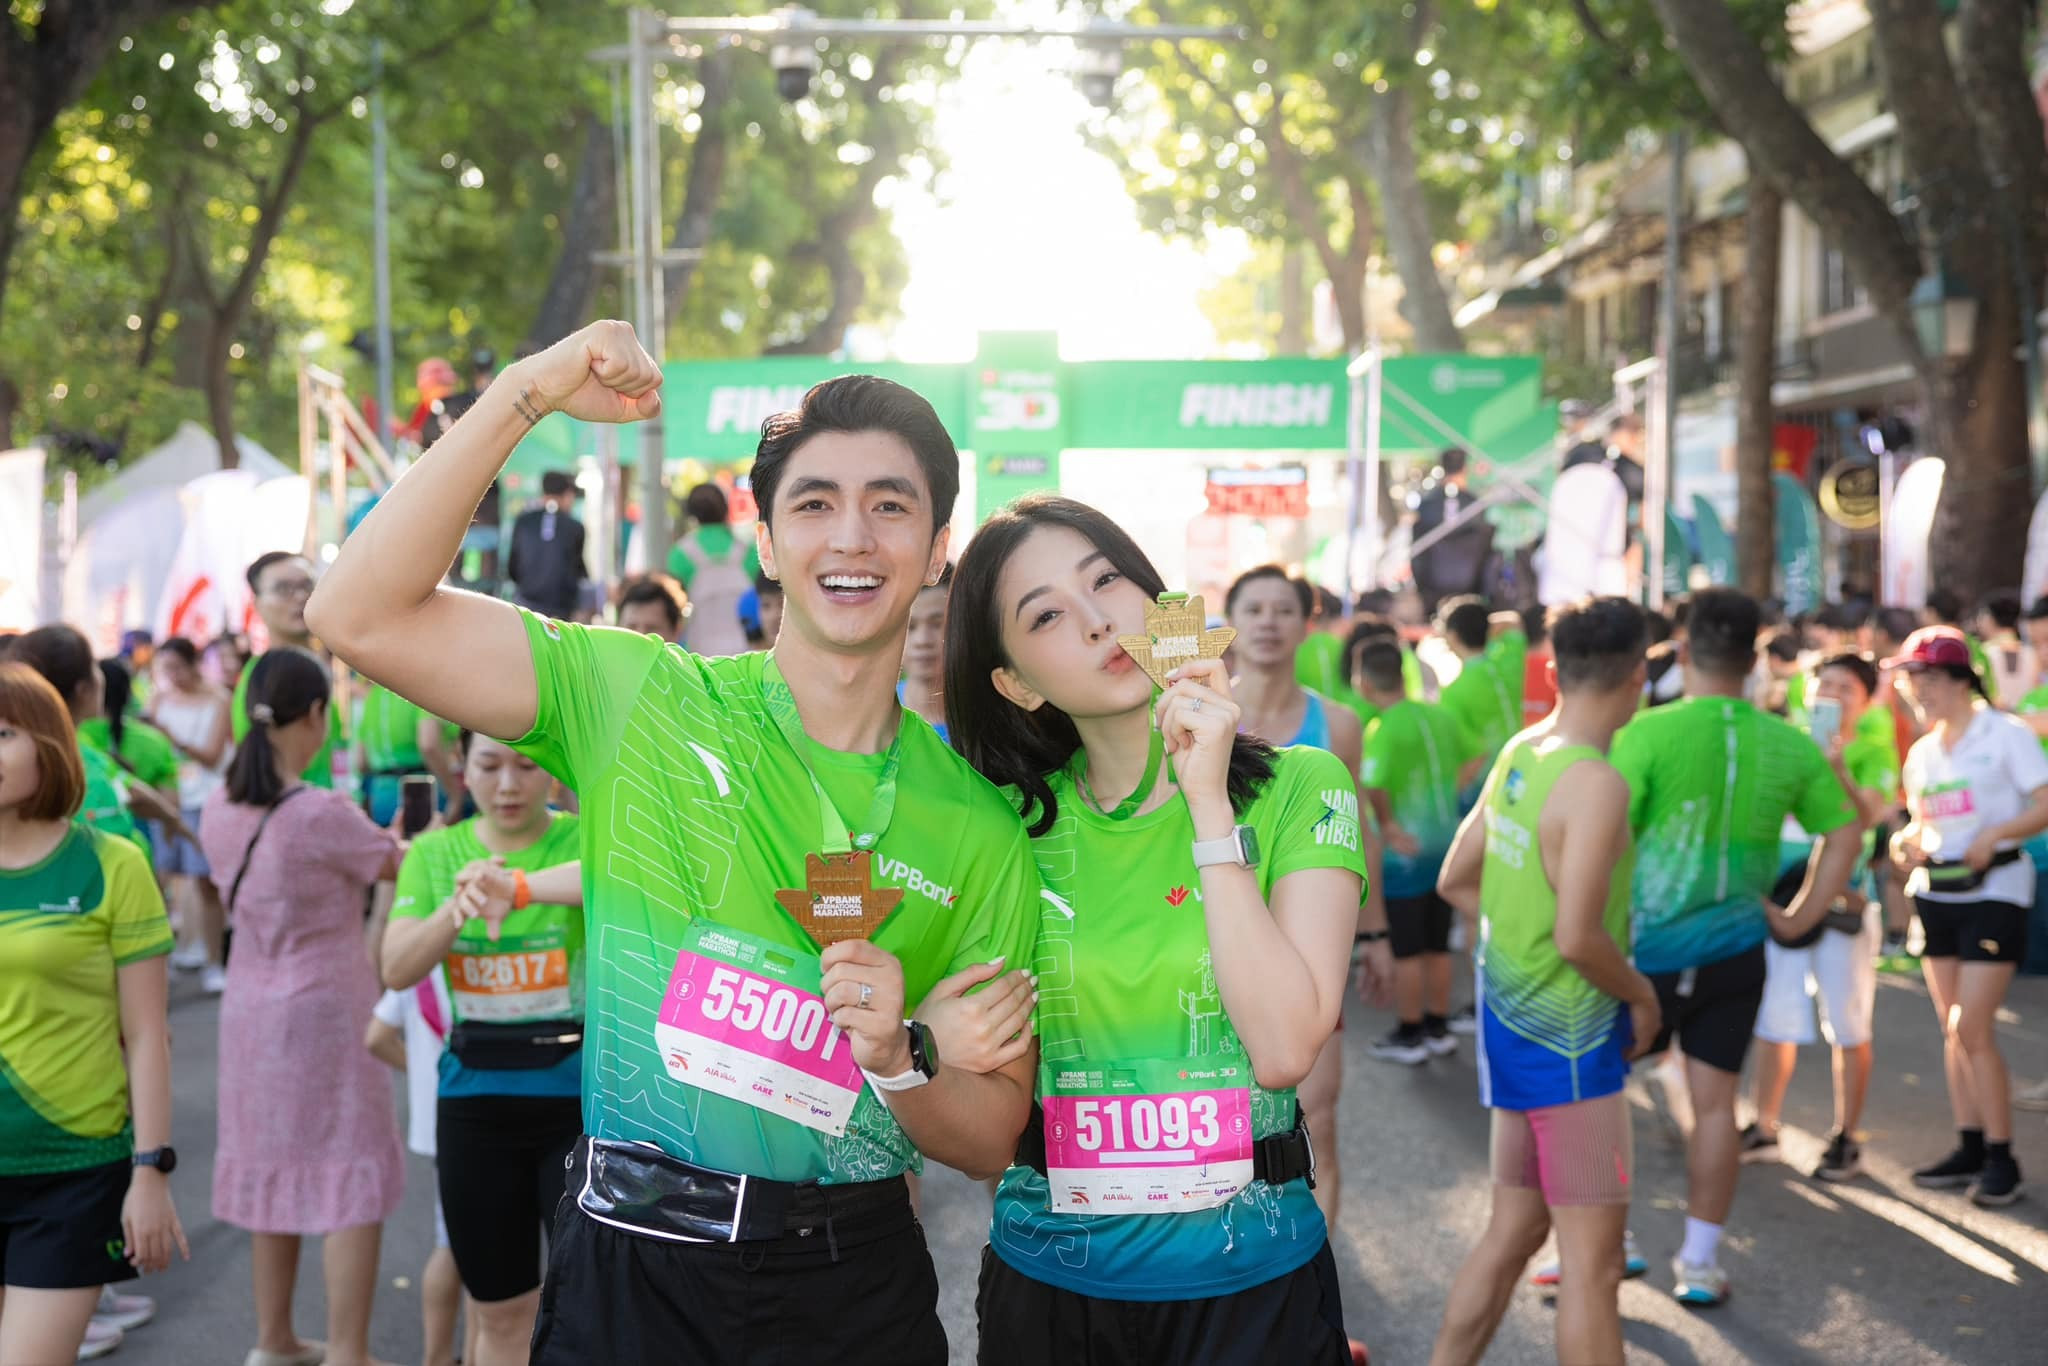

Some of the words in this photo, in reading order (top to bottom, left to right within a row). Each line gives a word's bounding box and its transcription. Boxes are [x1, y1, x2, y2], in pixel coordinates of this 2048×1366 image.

[1180, 382, 1334, 427] FINISH
[1315, 818, 1357, 852] VIBES
[877, 853, 957, 910] VPBank
[822, 895, 862, 904] VPBANK
[813, 909, 862, 917] MARATHON
[710, 931, 739, 947] VPBANK
[698, 940, 737, 958] MARATHON
[463, 953, 548, 987] 62617
[701, 967, 842, 1062] 55001
[704, 1067, 720, 1078] AIA
[1061, 1071, 1087, 1079] VPBANK
[1189, 1070, 1216, 1080] VPBank
[752, 1084, 774, 1096] CAKE
[1075, 1095, 1220, 1151] 51093
[1235, 1118, 1242, 1128] 5
[1055, 1125, 1062, 1136] 5
[1103, 1193, 1116, 1201] AIA
[1147, 1193, 1169, 1201] CAKE
